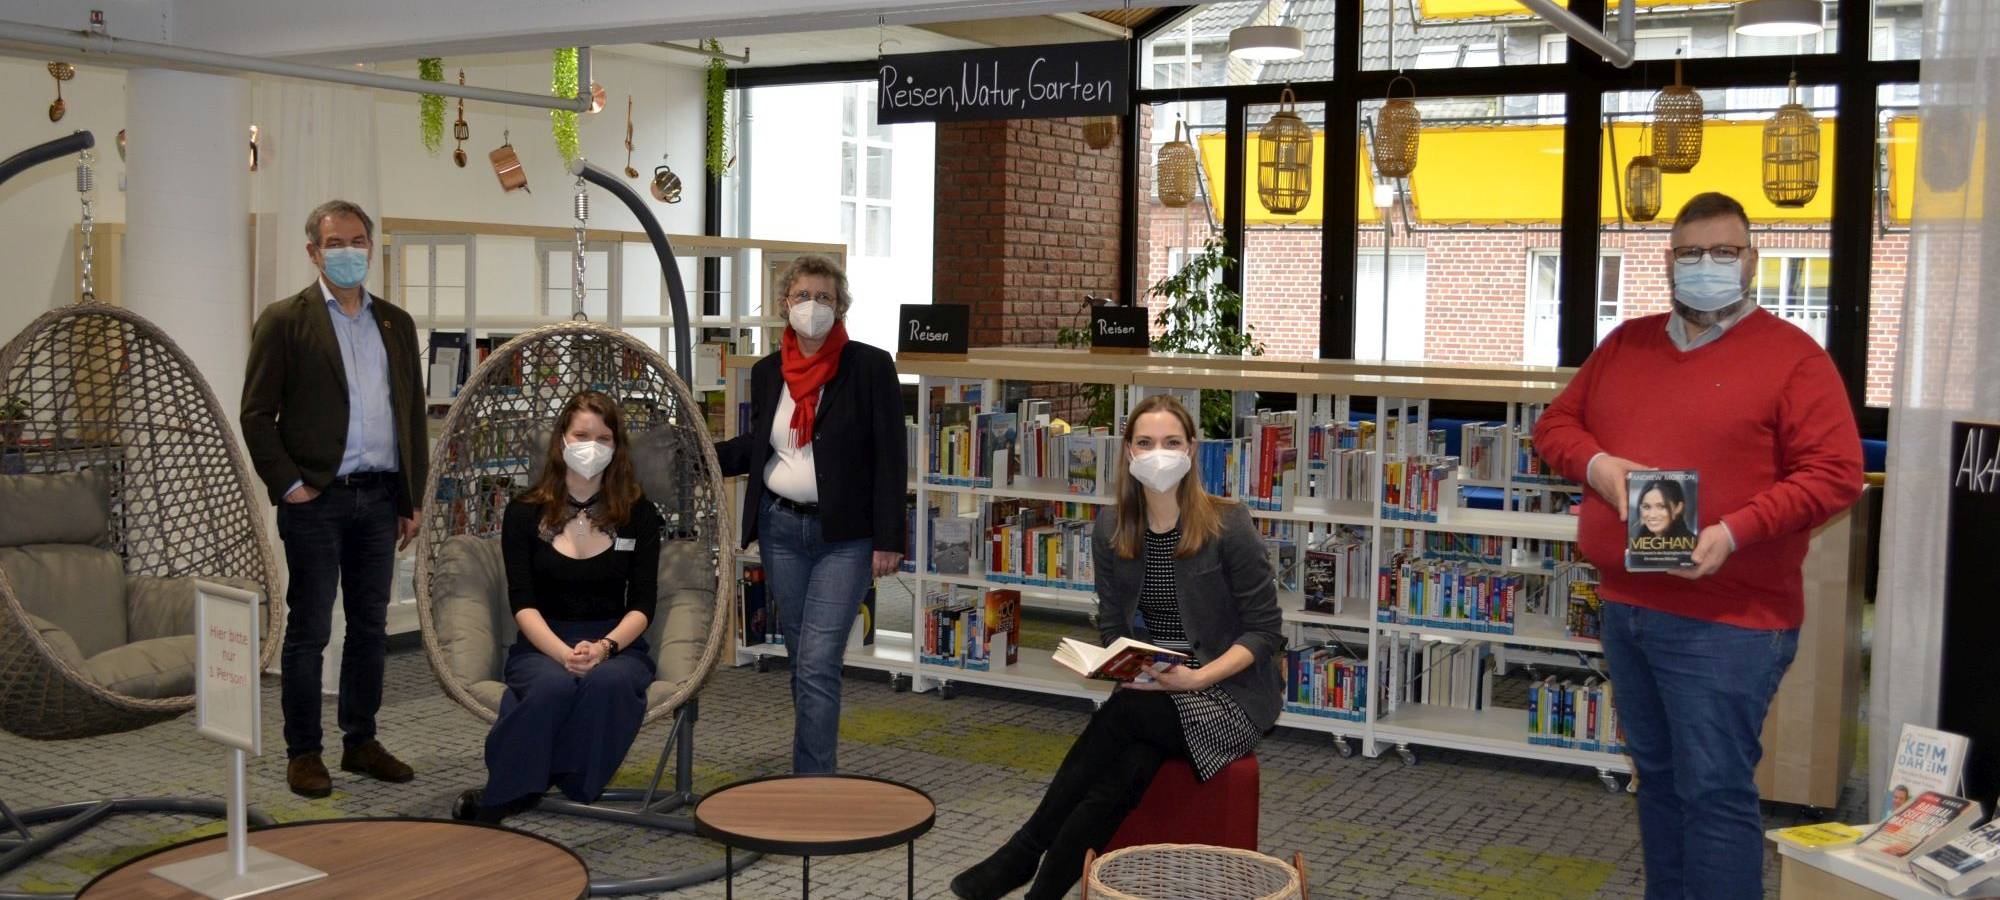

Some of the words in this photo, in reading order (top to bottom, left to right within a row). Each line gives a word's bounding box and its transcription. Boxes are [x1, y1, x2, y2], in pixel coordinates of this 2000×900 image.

[1028, 57, 1112, 102] Garten
[908, 319, 949, 342] Reisen
[1097, 318, 1135, 336] Reisen
[1630, 536, 1695, 550] MEGHAN
[210, 623, 226, 640] Hier
[229, 629, 249, 646] bitte
[222, 650, 237, 662] nur
[1904, 736, 1947, 762] KEIM
